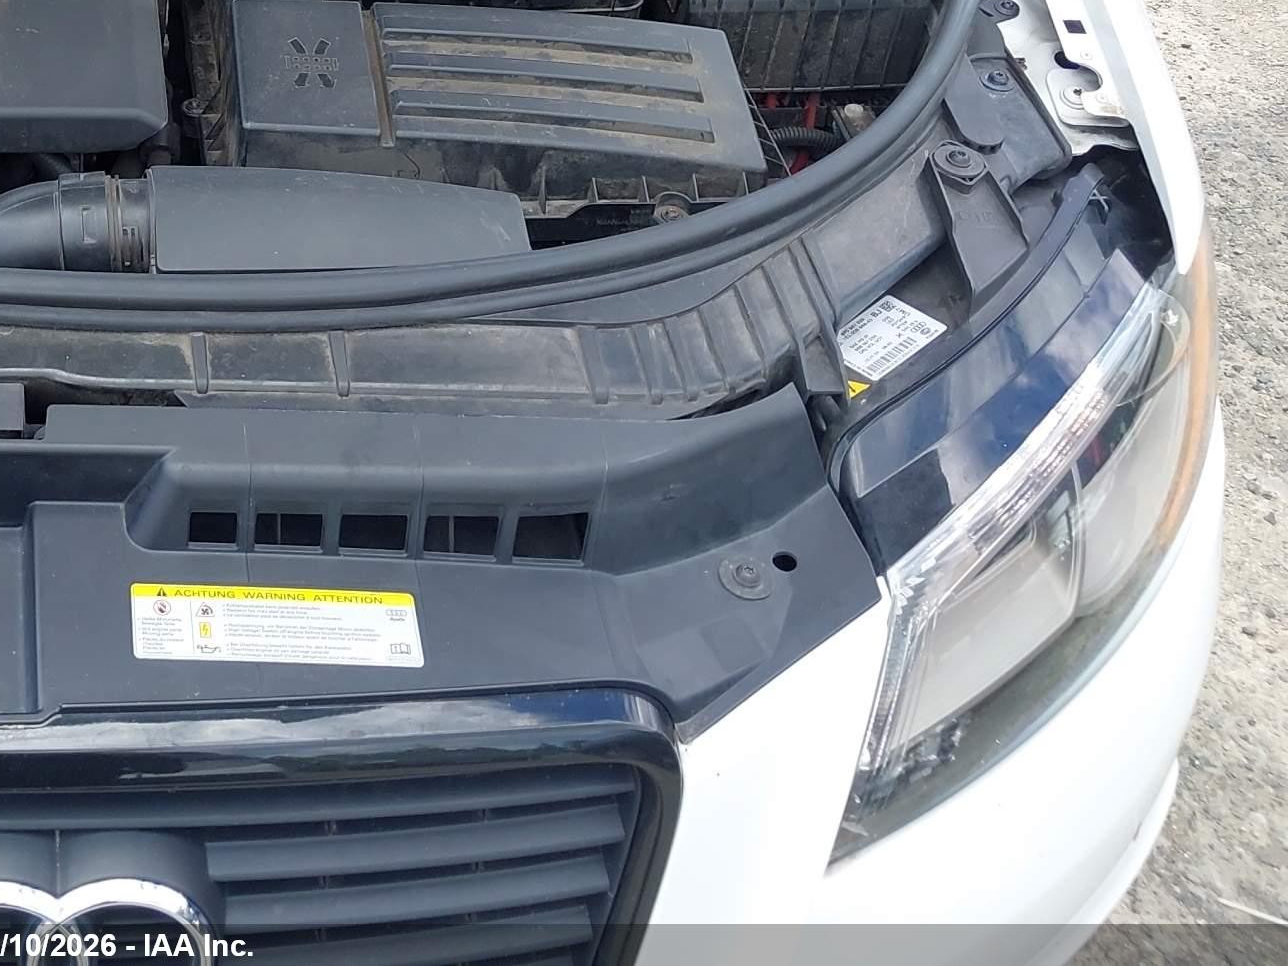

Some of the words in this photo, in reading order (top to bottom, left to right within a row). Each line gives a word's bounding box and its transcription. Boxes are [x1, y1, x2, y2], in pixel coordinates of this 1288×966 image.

[173, 589, 236, 600] ACHTUNG
[242, 592, 306, 602] WARNING
[313, 594, 383, 605] ATTENTION
